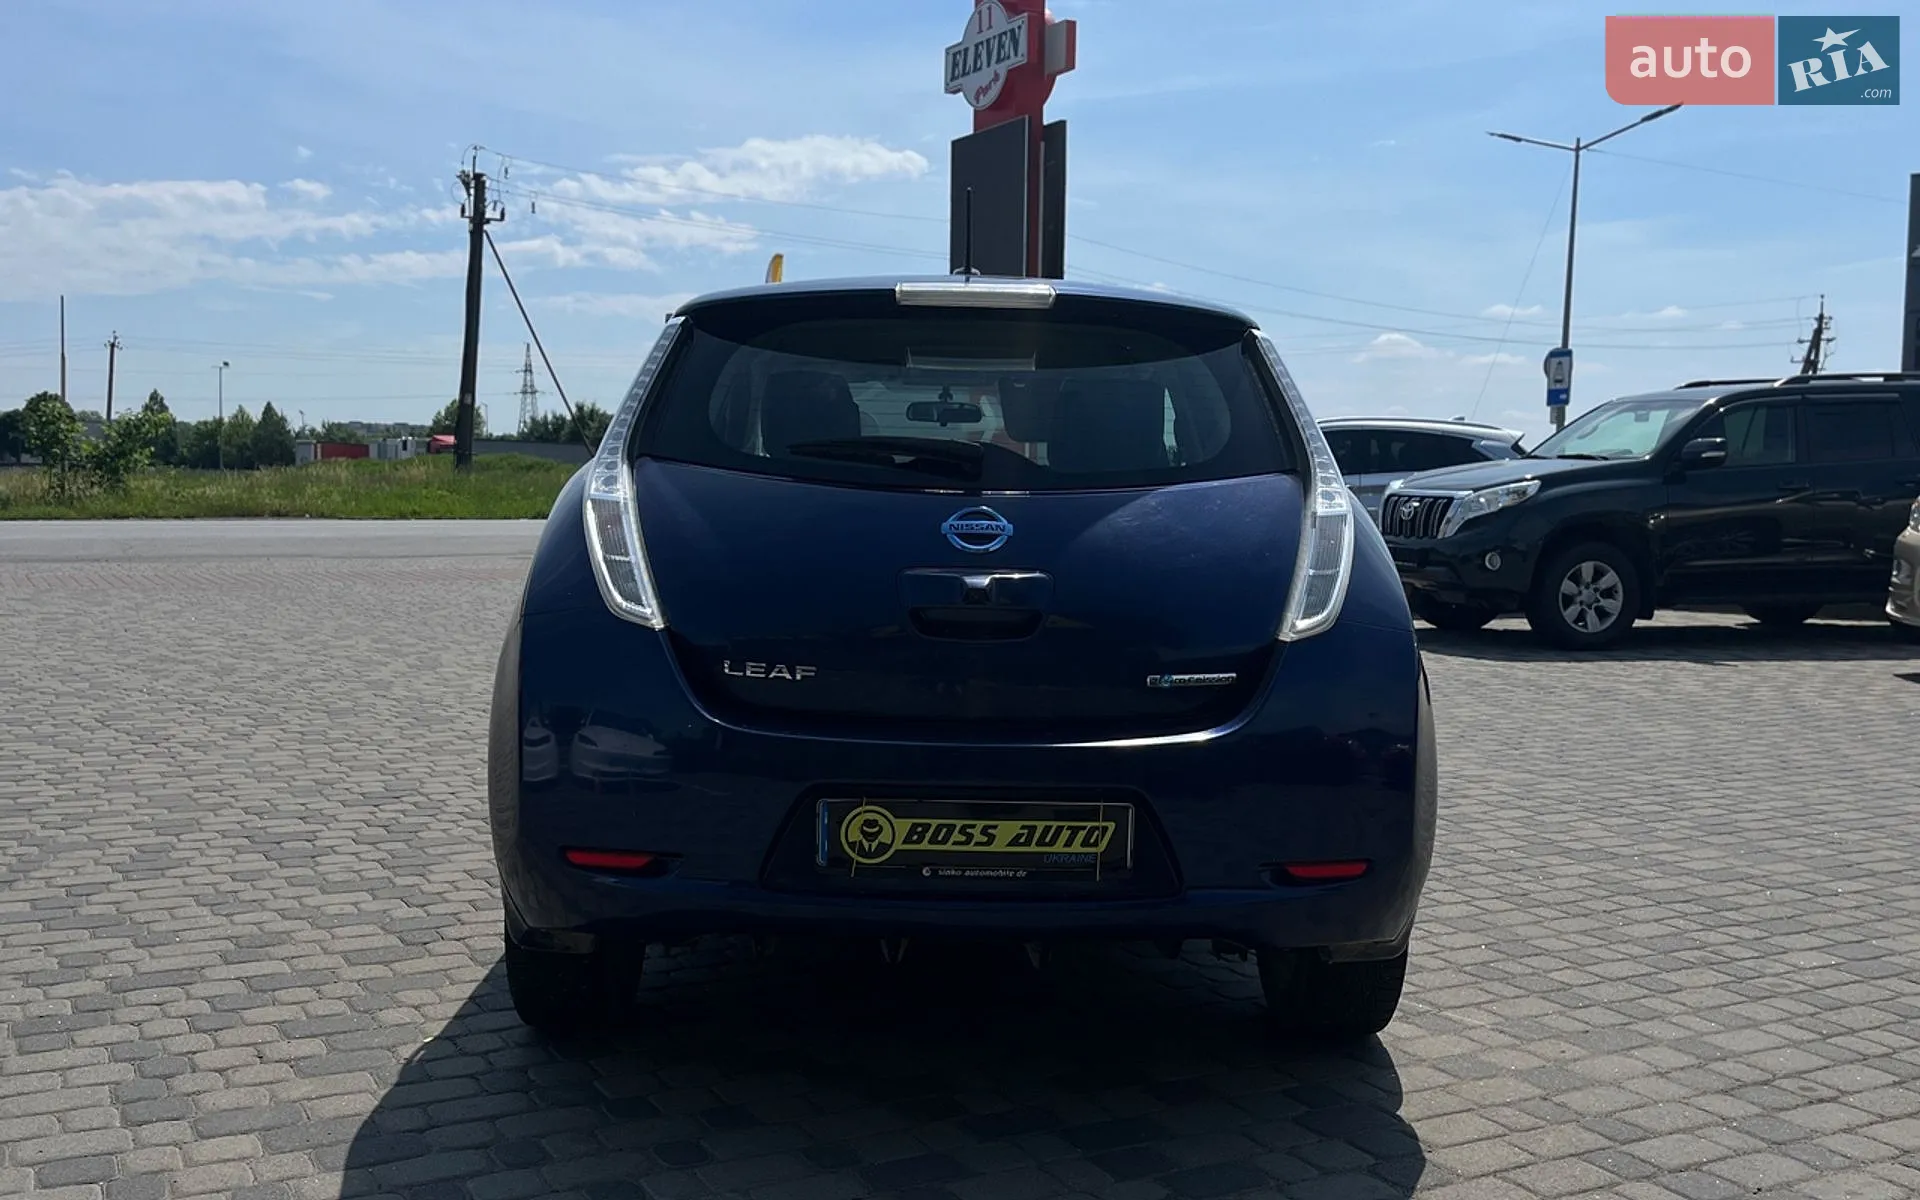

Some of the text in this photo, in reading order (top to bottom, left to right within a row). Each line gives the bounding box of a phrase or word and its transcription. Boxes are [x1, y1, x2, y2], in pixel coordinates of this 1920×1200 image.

[976, 4, 994, 34] 11
[950, 24, 1023, 83] ELEVEN
[973, 69, 1001, 105] Park
[948, 522, 1006, 532] NISSAN
[723, 659, 818, 681] LEAF
[901, 822, 1111, 849] BOSS AUTO
[1043, 853, 1097, 865] UKRAINE
